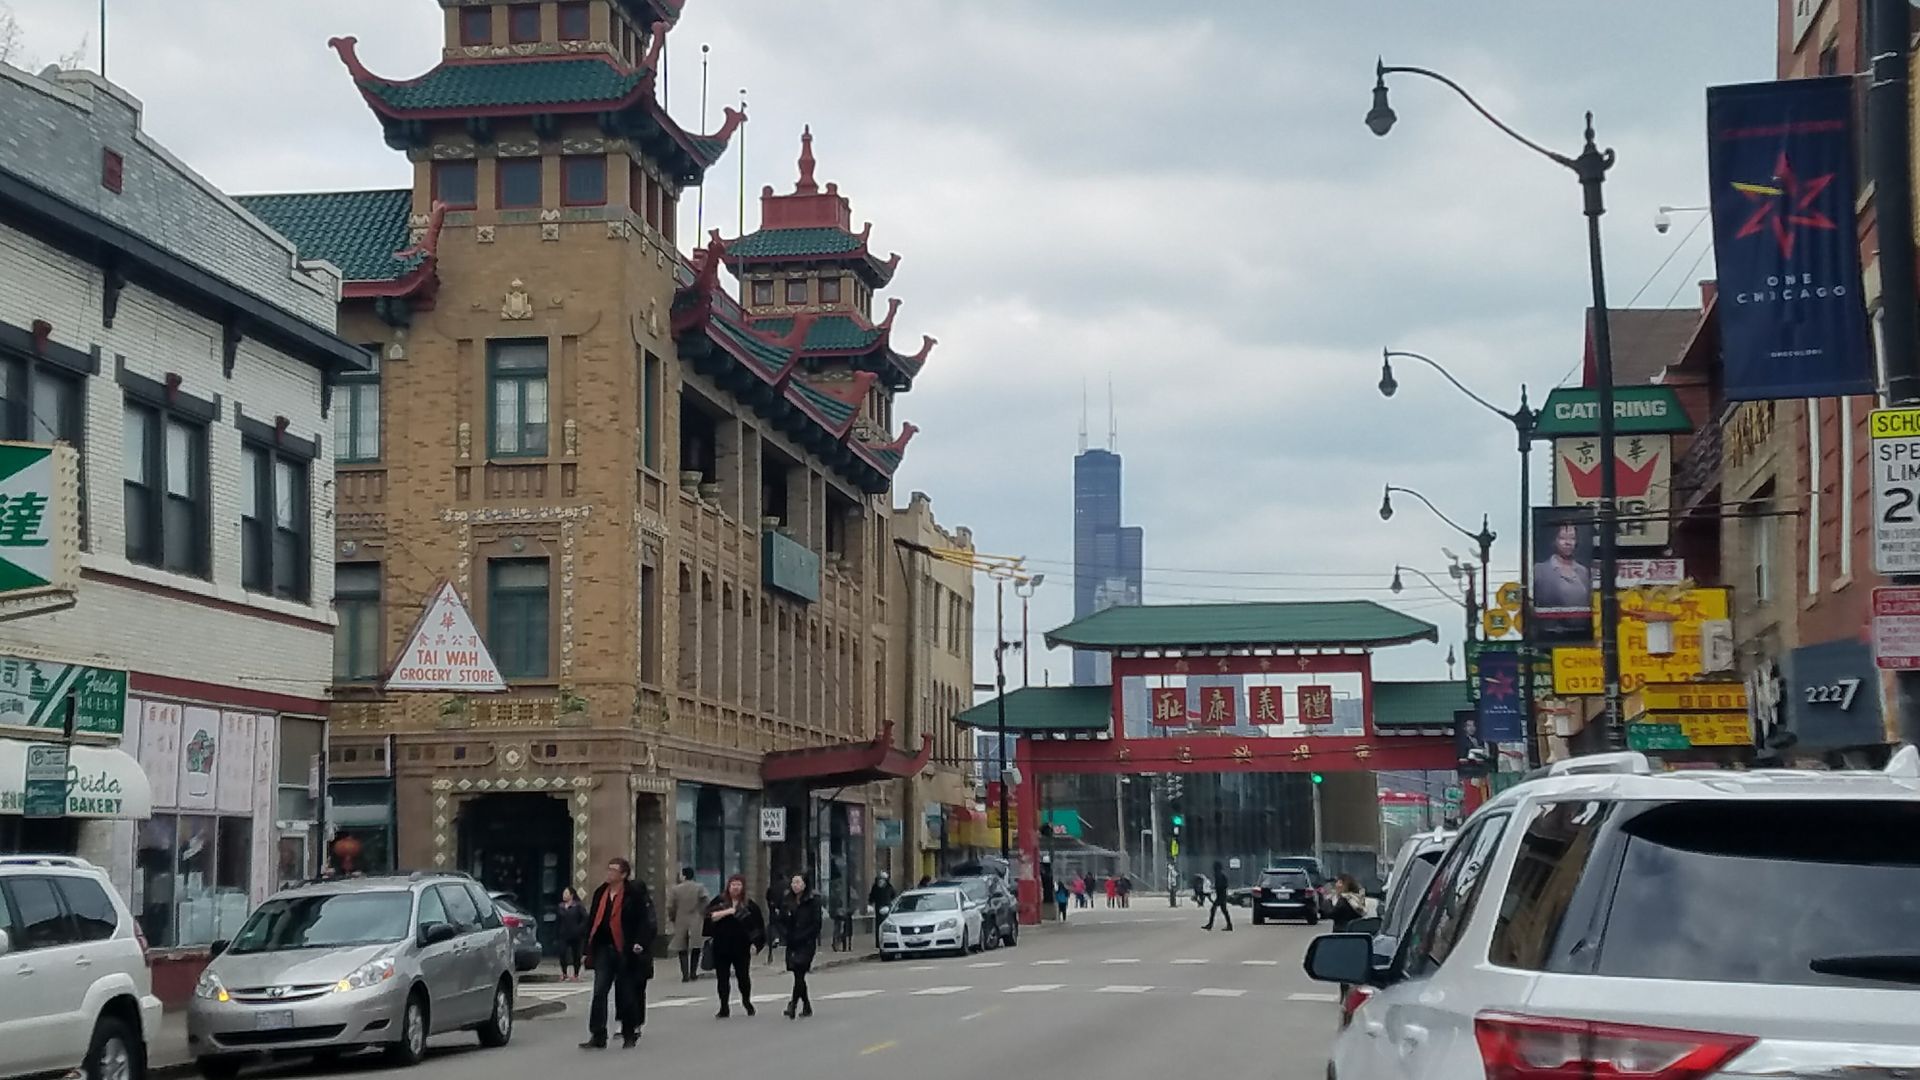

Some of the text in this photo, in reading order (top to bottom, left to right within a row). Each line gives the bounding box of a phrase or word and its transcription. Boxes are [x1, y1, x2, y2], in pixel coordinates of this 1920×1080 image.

[1767, 273, 1812, 286] ONE
[1736, 285, 1846, 304] CHICAGO
[1555, 400, 1667, 420] CATRING
[1884, 486, 1920, 523] 2
[416, 632, 478, 648] 食品公司
[417, 650, 478, 666] TAI WAH
[400, 668, 494, 682] GROCERY STORE
[1805, 679, 1860, 710] 2227
[69, 797, 122, 813] BAKERY
